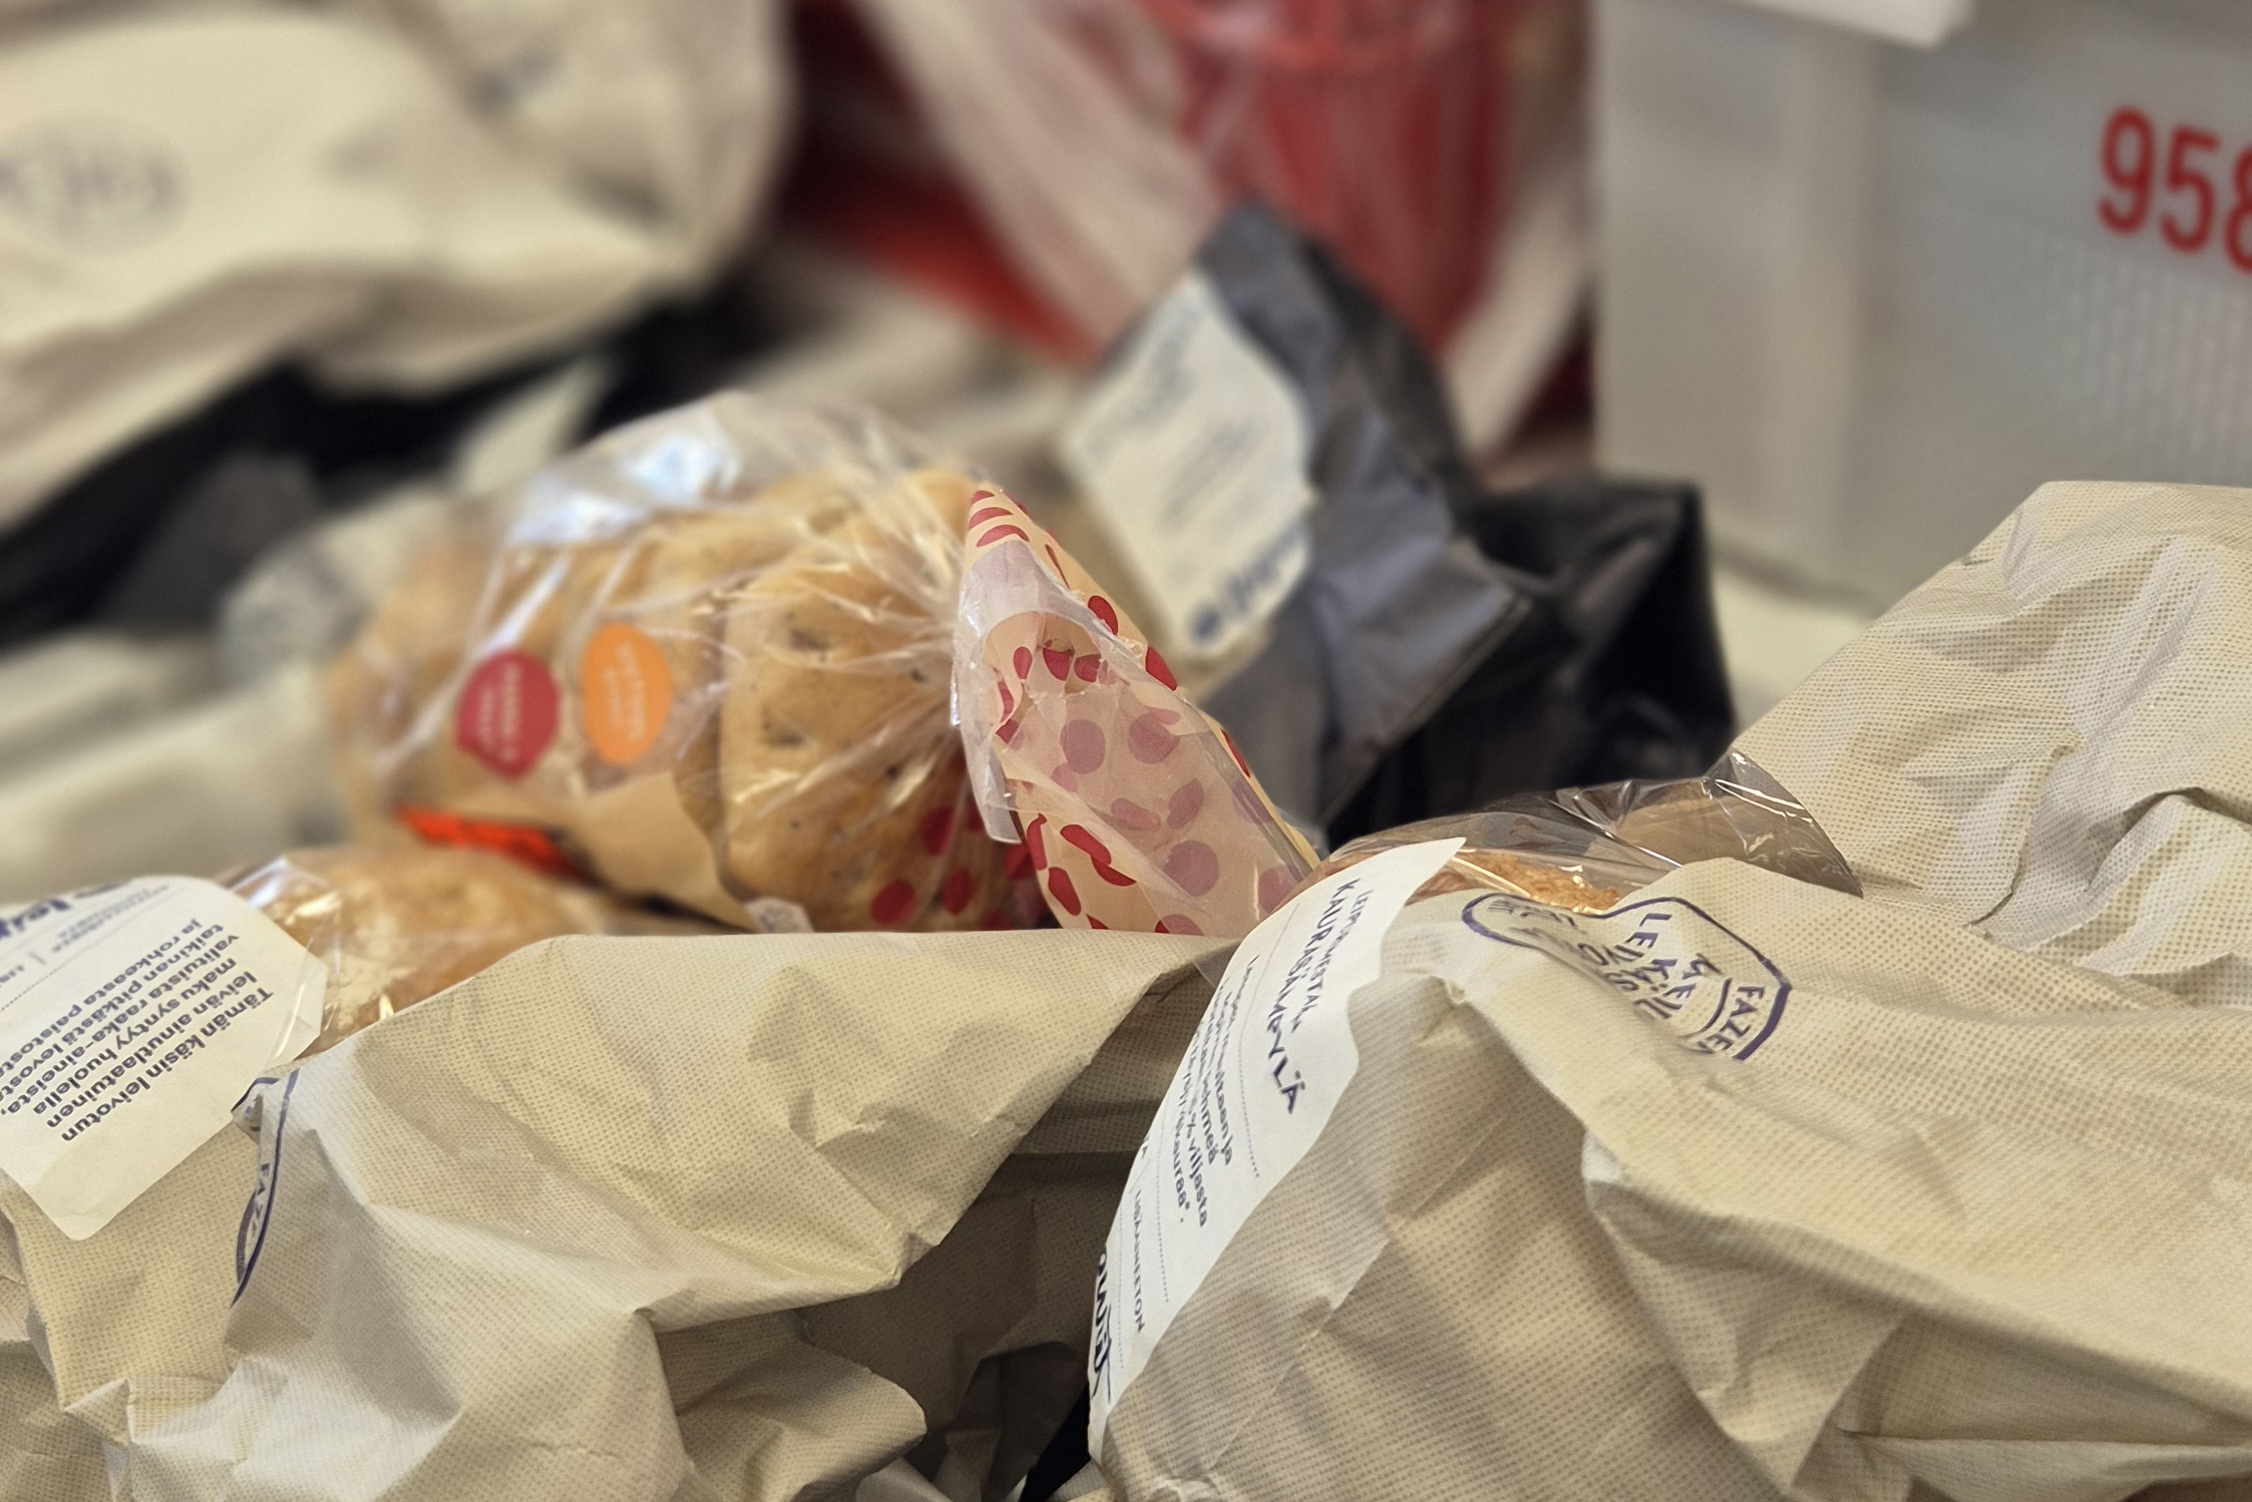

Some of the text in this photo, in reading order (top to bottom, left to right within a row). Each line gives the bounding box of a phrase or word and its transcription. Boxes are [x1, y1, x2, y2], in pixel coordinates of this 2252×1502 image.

[83, 935, 181, 1004] rohkeasta
[143, 924, 224, 981] taikinan
[182, 918, 202, 934] ja
[0, 935, 239, 1115] valituista raaka-aineista,
[33, 958, 237, 1114] maku syntyy huolella
[47, 971, 257, 1128] leivän ainutlaatuinen
[62, 980, 143, 1046] pitkästä
[1267, 878, 1360, 1114] KAURASÄMPYLÄ
[61, 988, 274, 1141] Tämän käsin leivotun
[1189, 1137, 1208, 1227] viljasta
